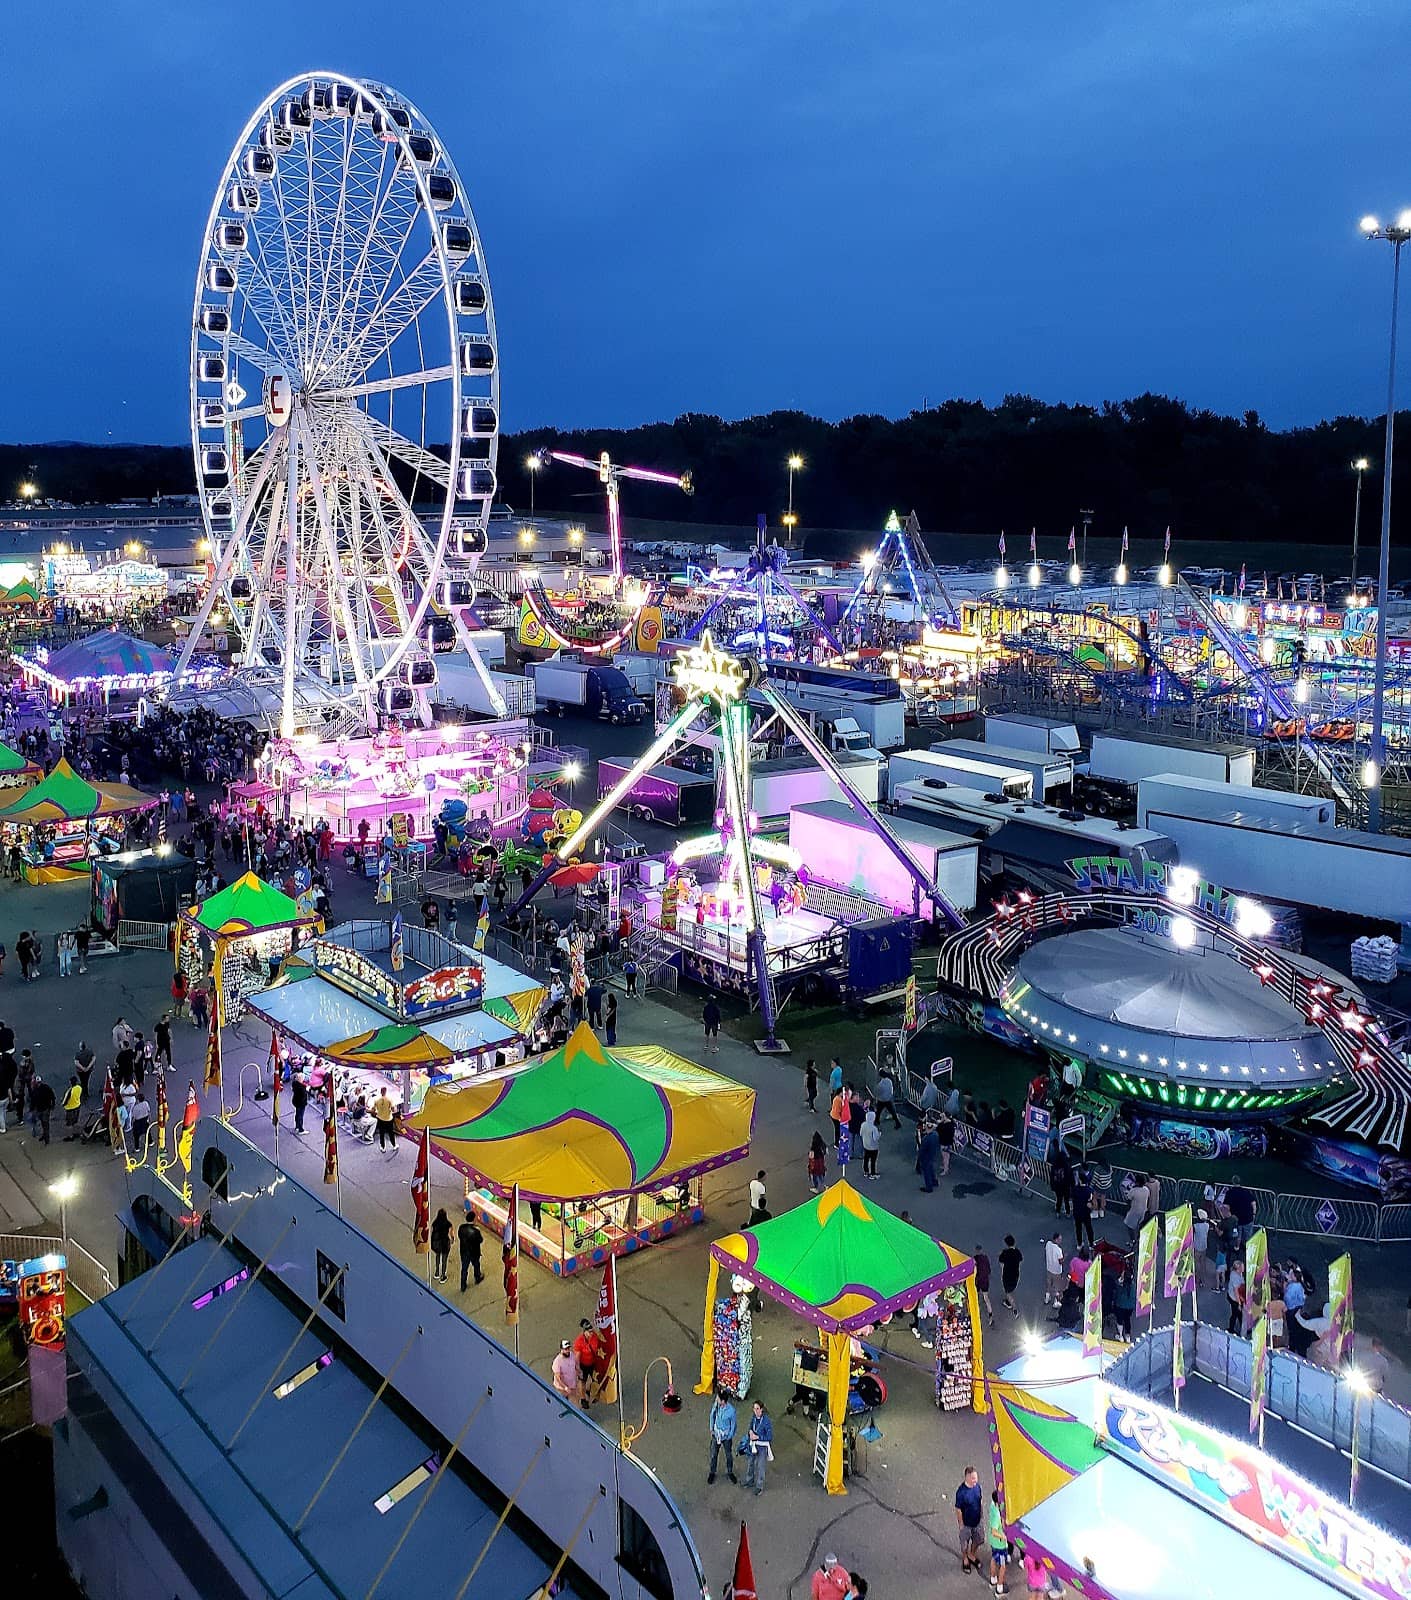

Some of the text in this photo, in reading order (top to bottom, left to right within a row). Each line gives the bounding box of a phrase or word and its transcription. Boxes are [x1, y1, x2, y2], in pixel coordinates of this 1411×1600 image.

[271, 375, 284, 414] E
[1064, 855, 1262, 934] STARHI
[1131, 906, 1189, 943] 300
[1256, 1469, 1411, 1597] WATER
